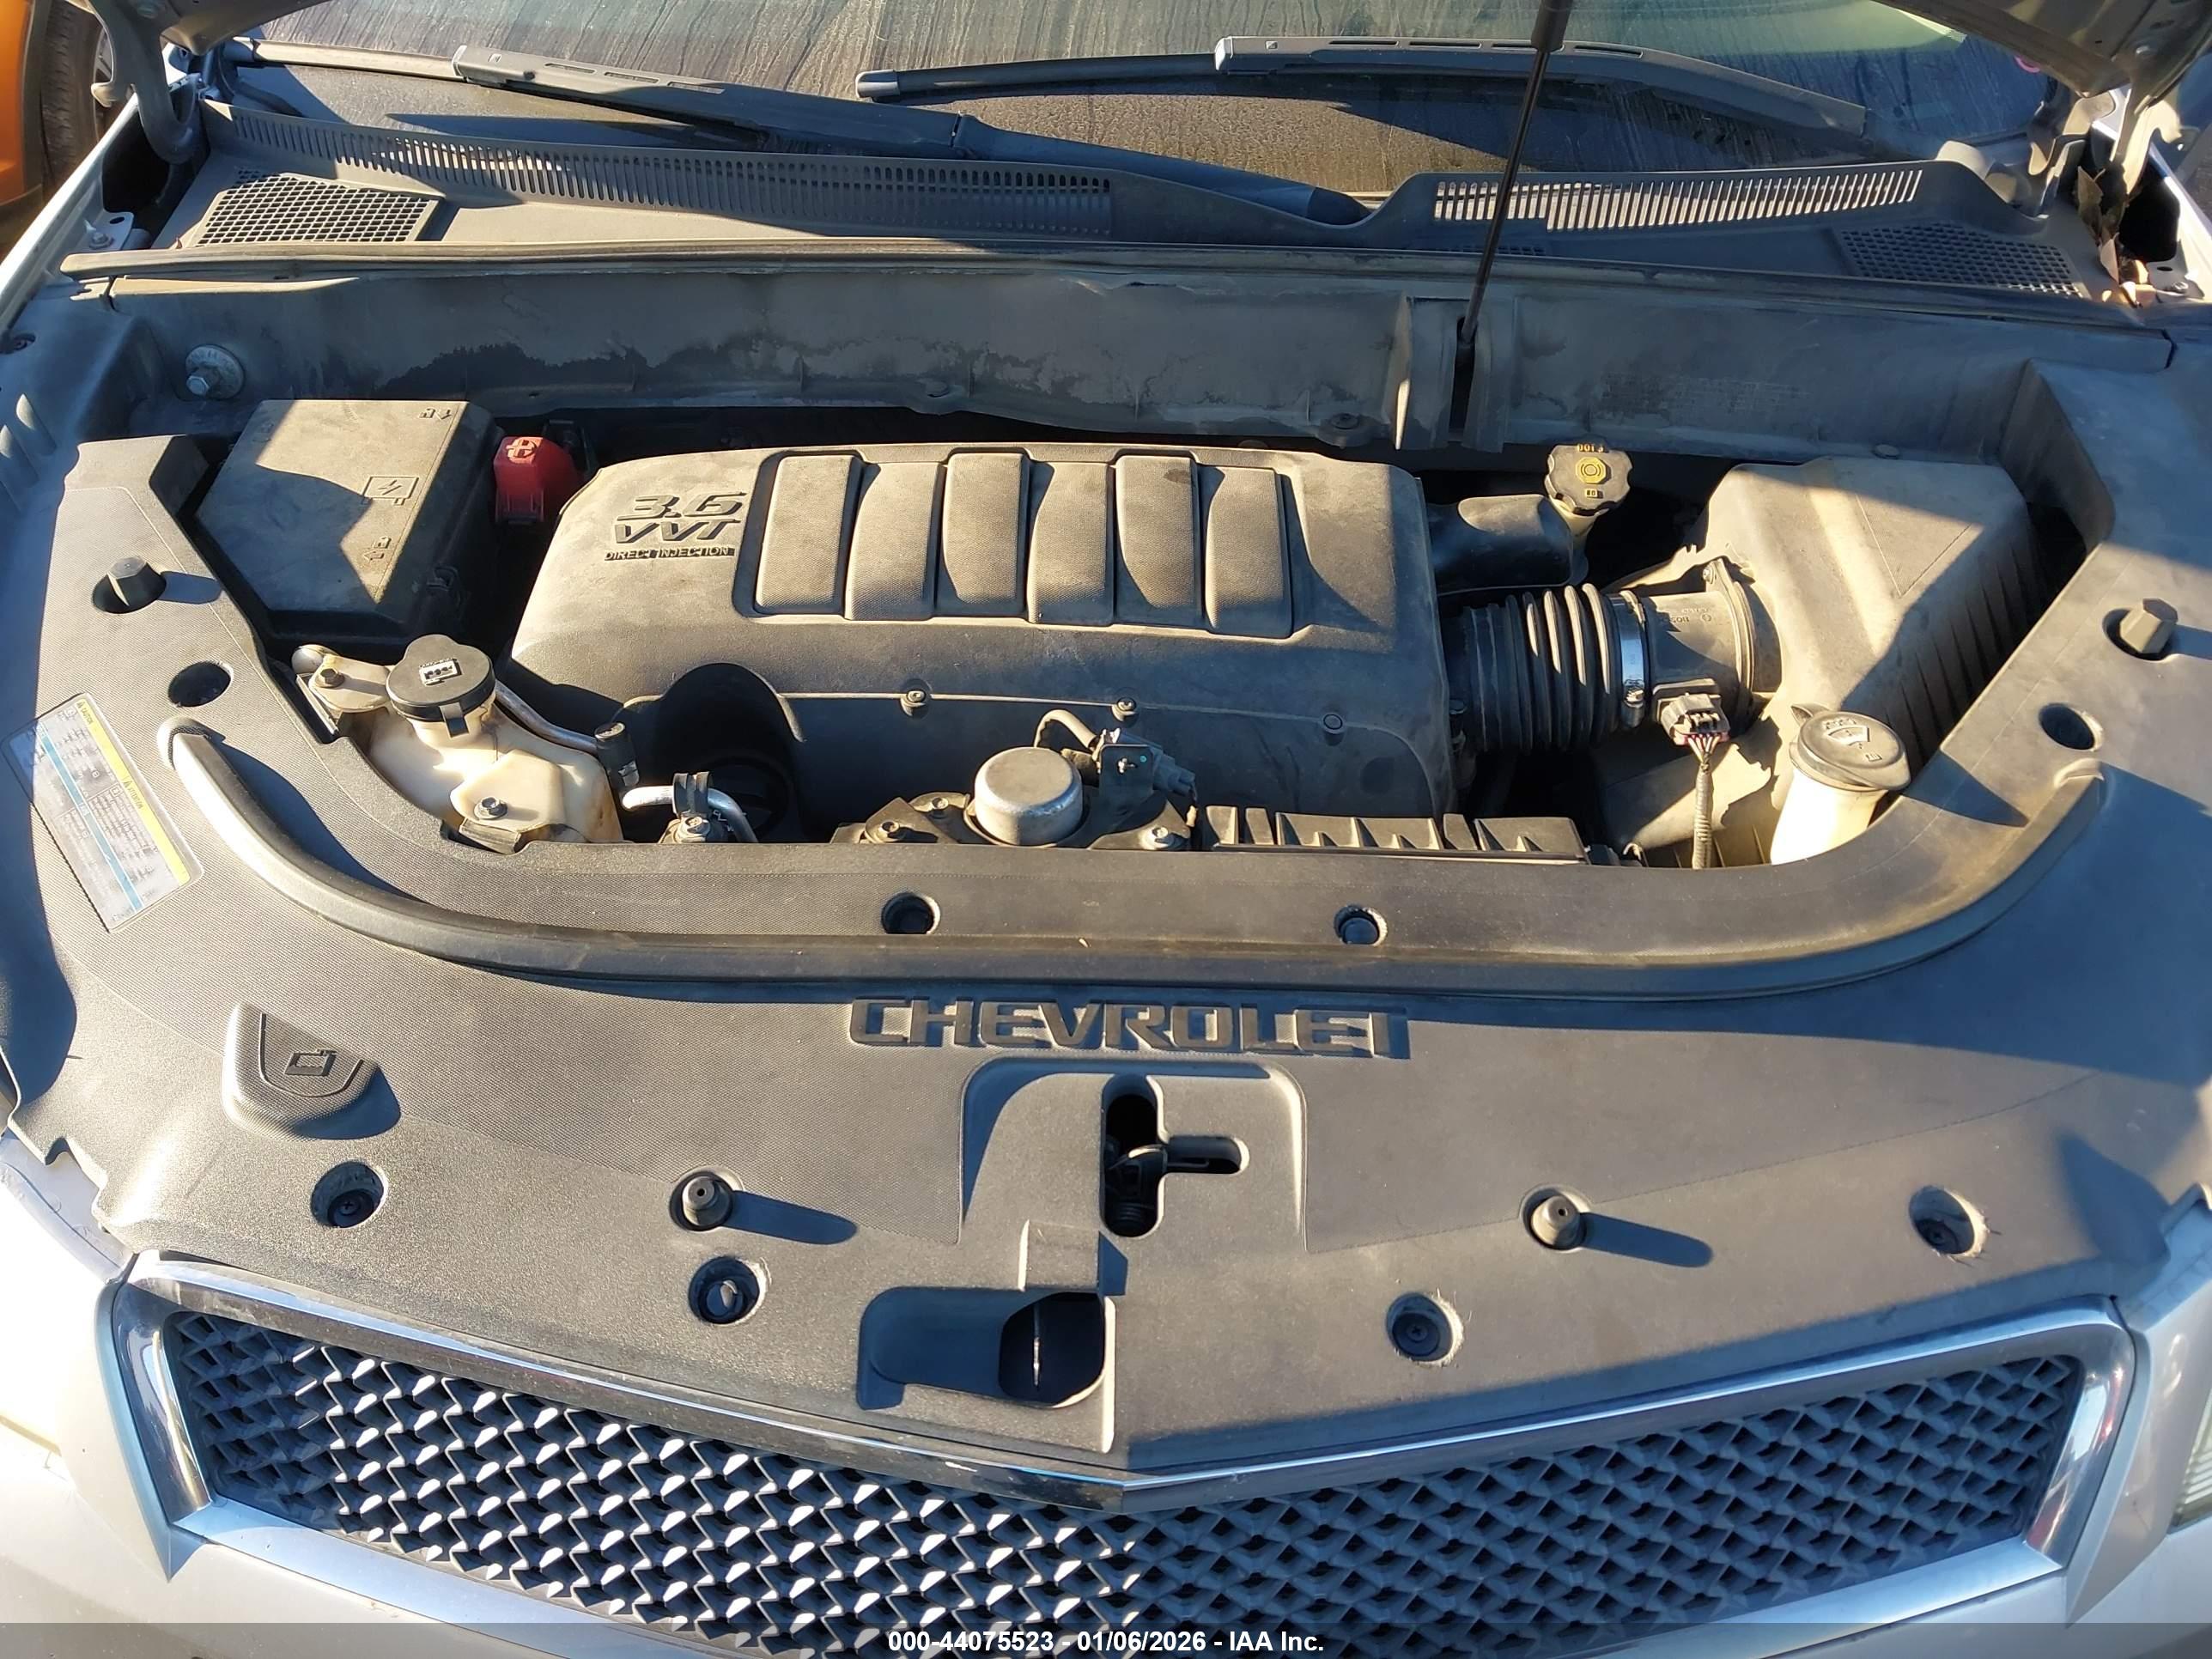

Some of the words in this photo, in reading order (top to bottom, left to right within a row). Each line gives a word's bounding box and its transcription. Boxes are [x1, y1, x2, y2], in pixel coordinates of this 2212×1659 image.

[617, 491, 747, 521] 3.6
[615, 519, 741, 544] VVT
[605, 549, 657, 561] DIRECT
[658, 547, 736, 559] INJECTION
[848, 996, 1408, 1059] CHEVROLET
